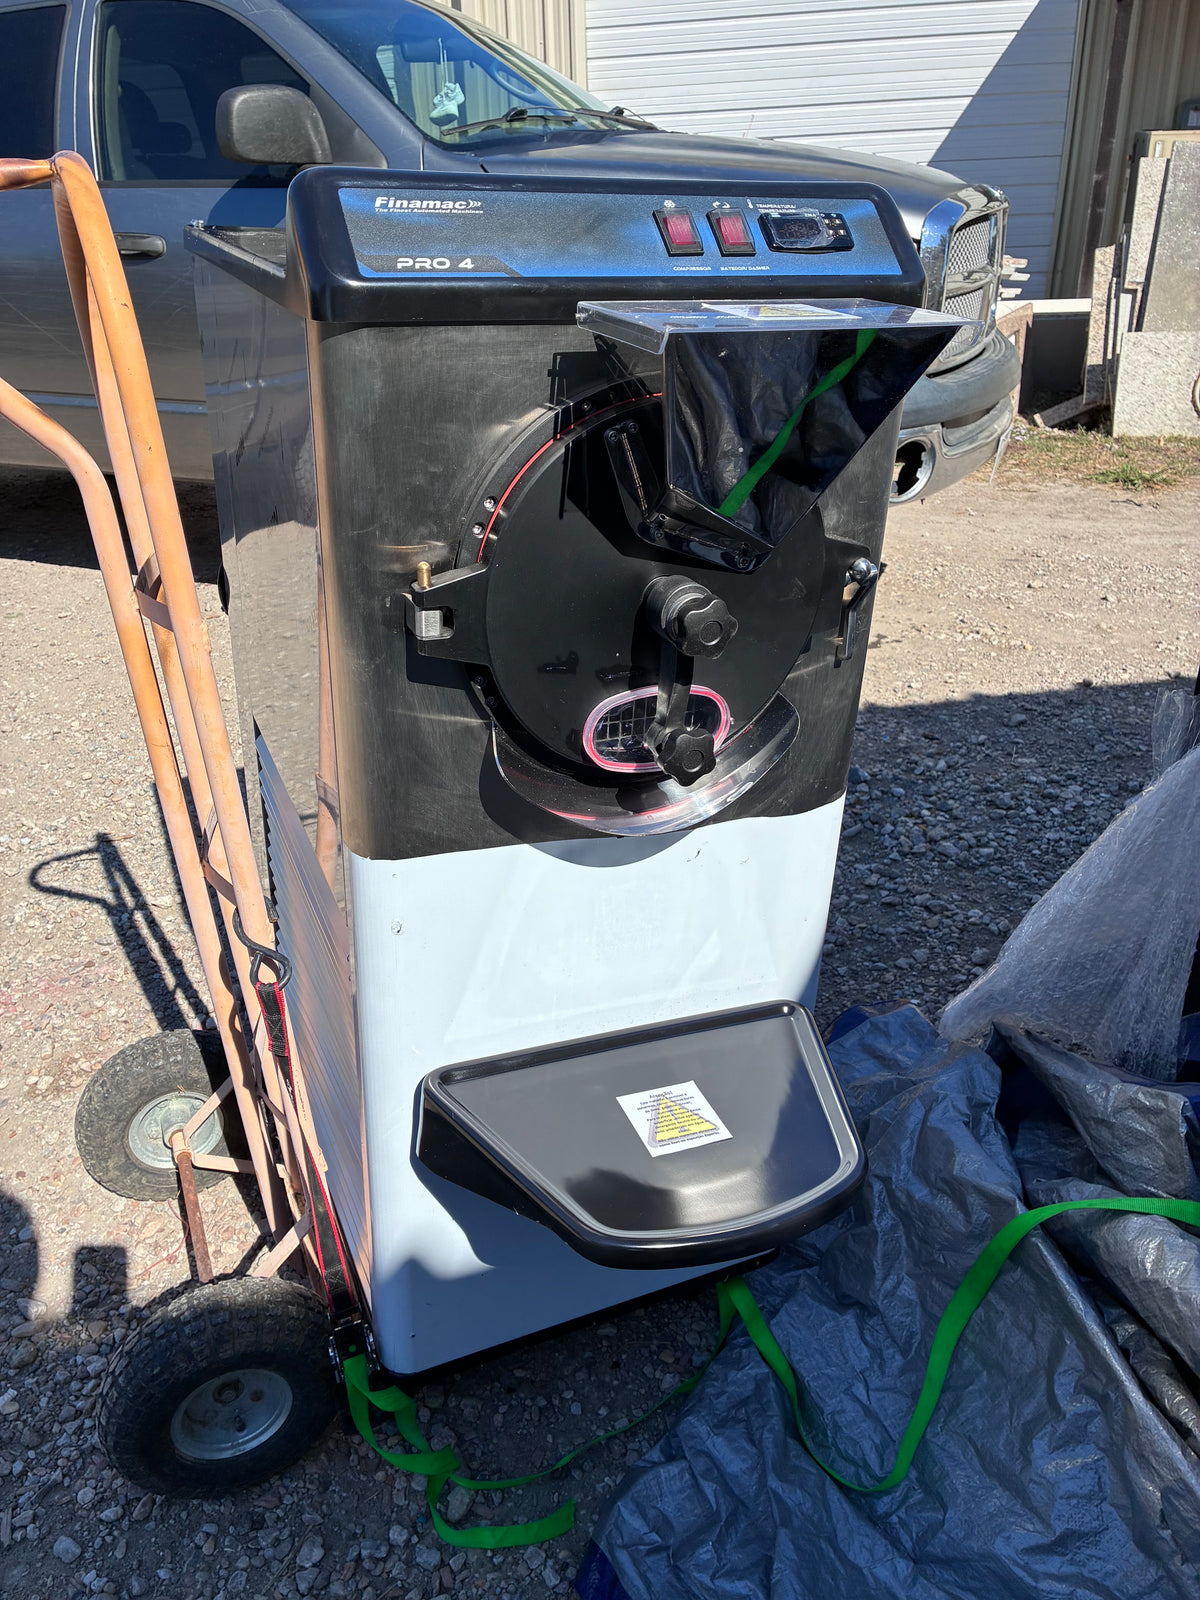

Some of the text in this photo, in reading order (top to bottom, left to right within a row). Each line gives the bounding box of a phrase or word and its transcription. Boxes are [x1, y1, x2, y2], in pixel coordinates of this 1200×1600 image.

[375, 197, 467, 209] Finamac
[396, 257, 475, 270] PRO 4
